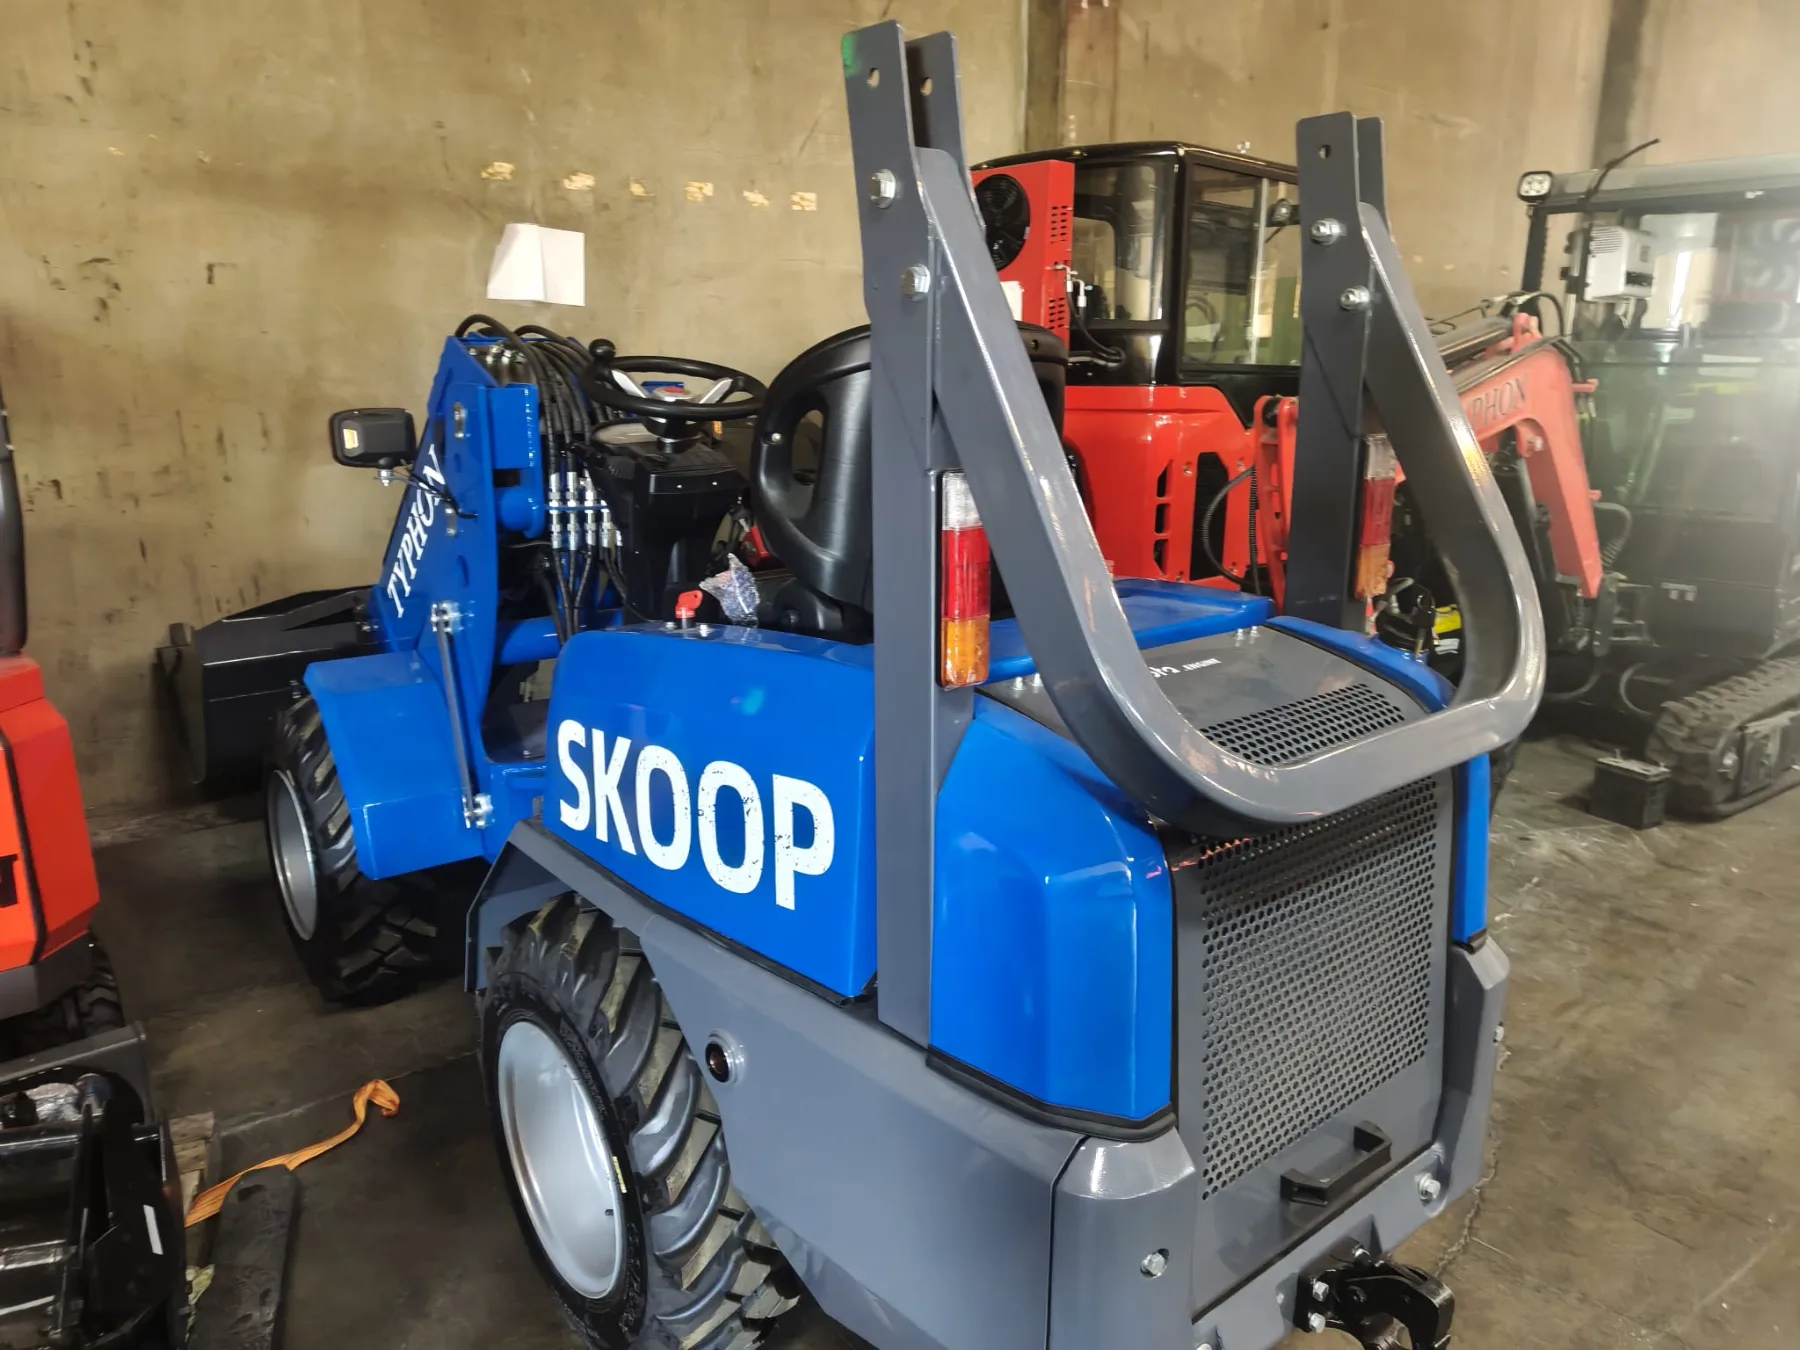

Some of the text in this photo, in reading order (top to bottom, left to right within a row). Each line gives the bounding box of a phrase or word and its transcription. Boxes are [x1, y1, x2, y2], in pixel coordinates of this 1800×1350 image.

[1470, 373, 1529, 424] PHON
[386, 443, 446, 619] TYPHON
[557, 719, 835, 911] SKOOP
